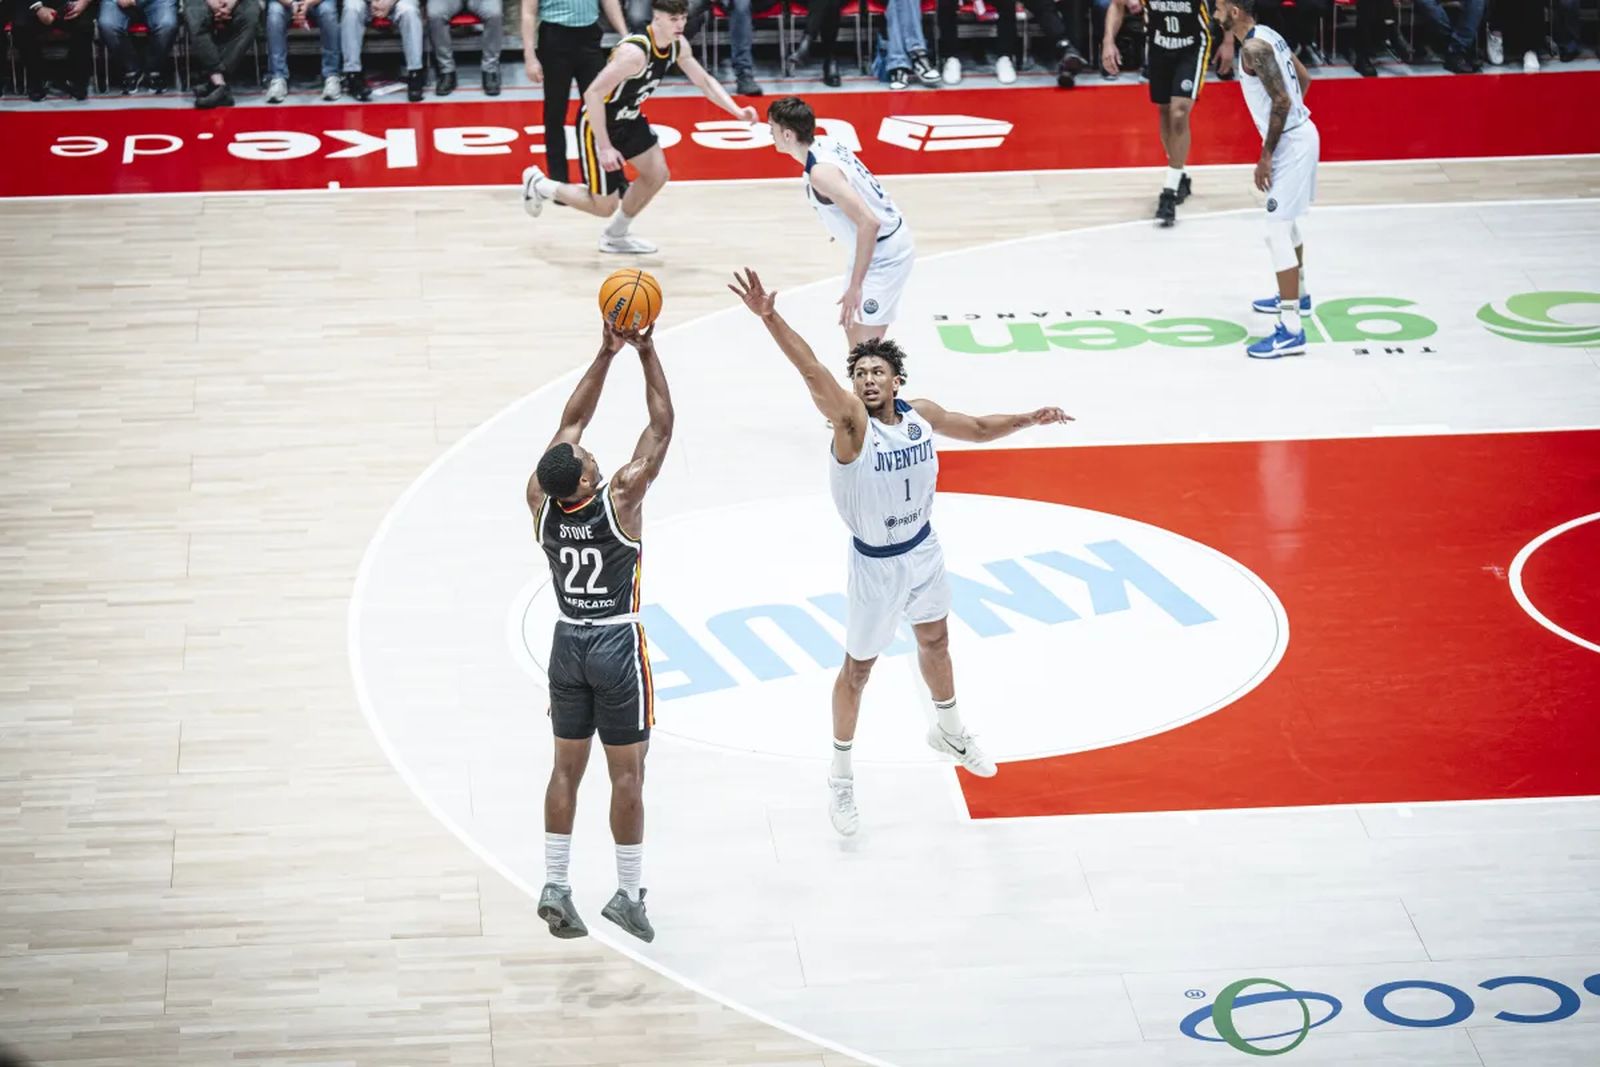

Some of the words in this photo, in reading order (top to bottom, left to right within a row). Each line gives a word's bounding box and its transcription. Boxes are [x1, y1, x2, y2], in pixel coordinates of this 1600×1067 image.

[1164, 15, 1181, 34] 10
[934, 308, 1165, 320] ALLIANCE
[1353, 345, 1437, 355] THE
[904, 478, 912, 502] 1
[560, 523, 595, 541] STOVE
[559, 546, 609, 595] 22
